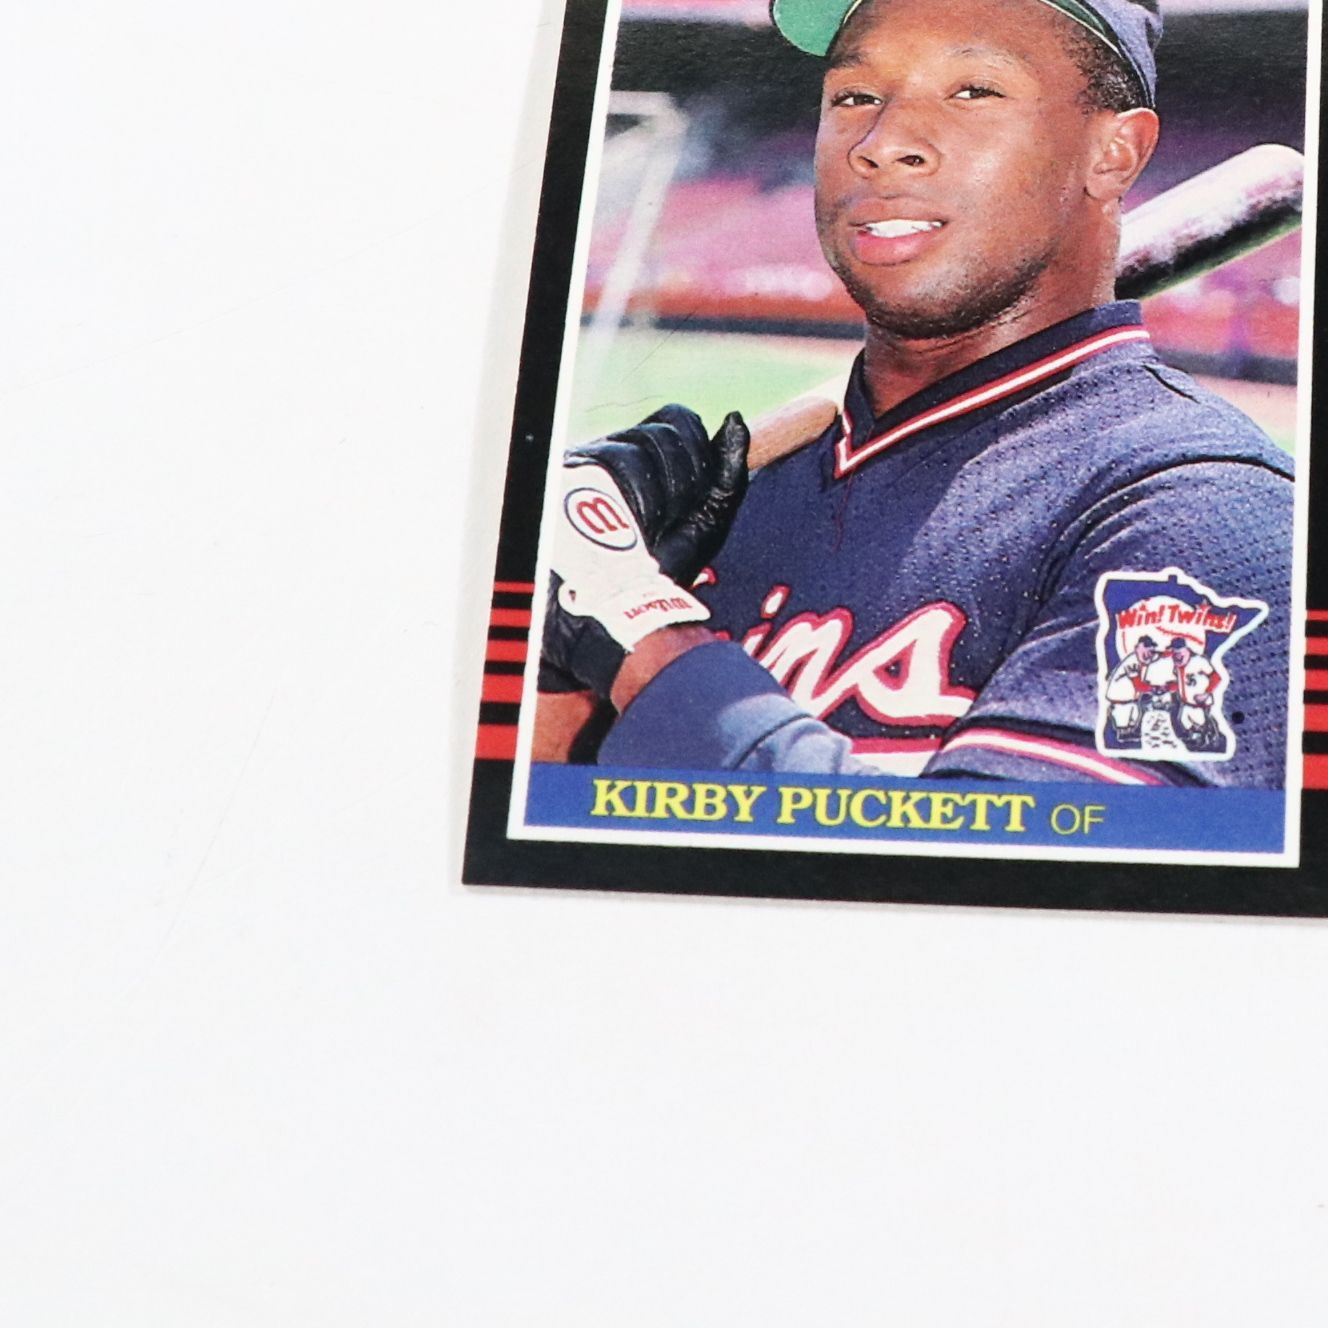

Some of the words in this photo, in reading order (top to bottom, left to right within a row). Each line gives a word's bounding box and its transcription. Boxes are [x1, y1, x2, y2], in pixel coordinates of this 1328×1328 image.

[1114, 603, 1167, 630] Win!
[1167, 601, 1238, 633] Twins!
[589, 778, 765, 821] KIRBY
[776, 788, 1036, 833] PUCKETT
[1050, 803, 1106, 835] OF
